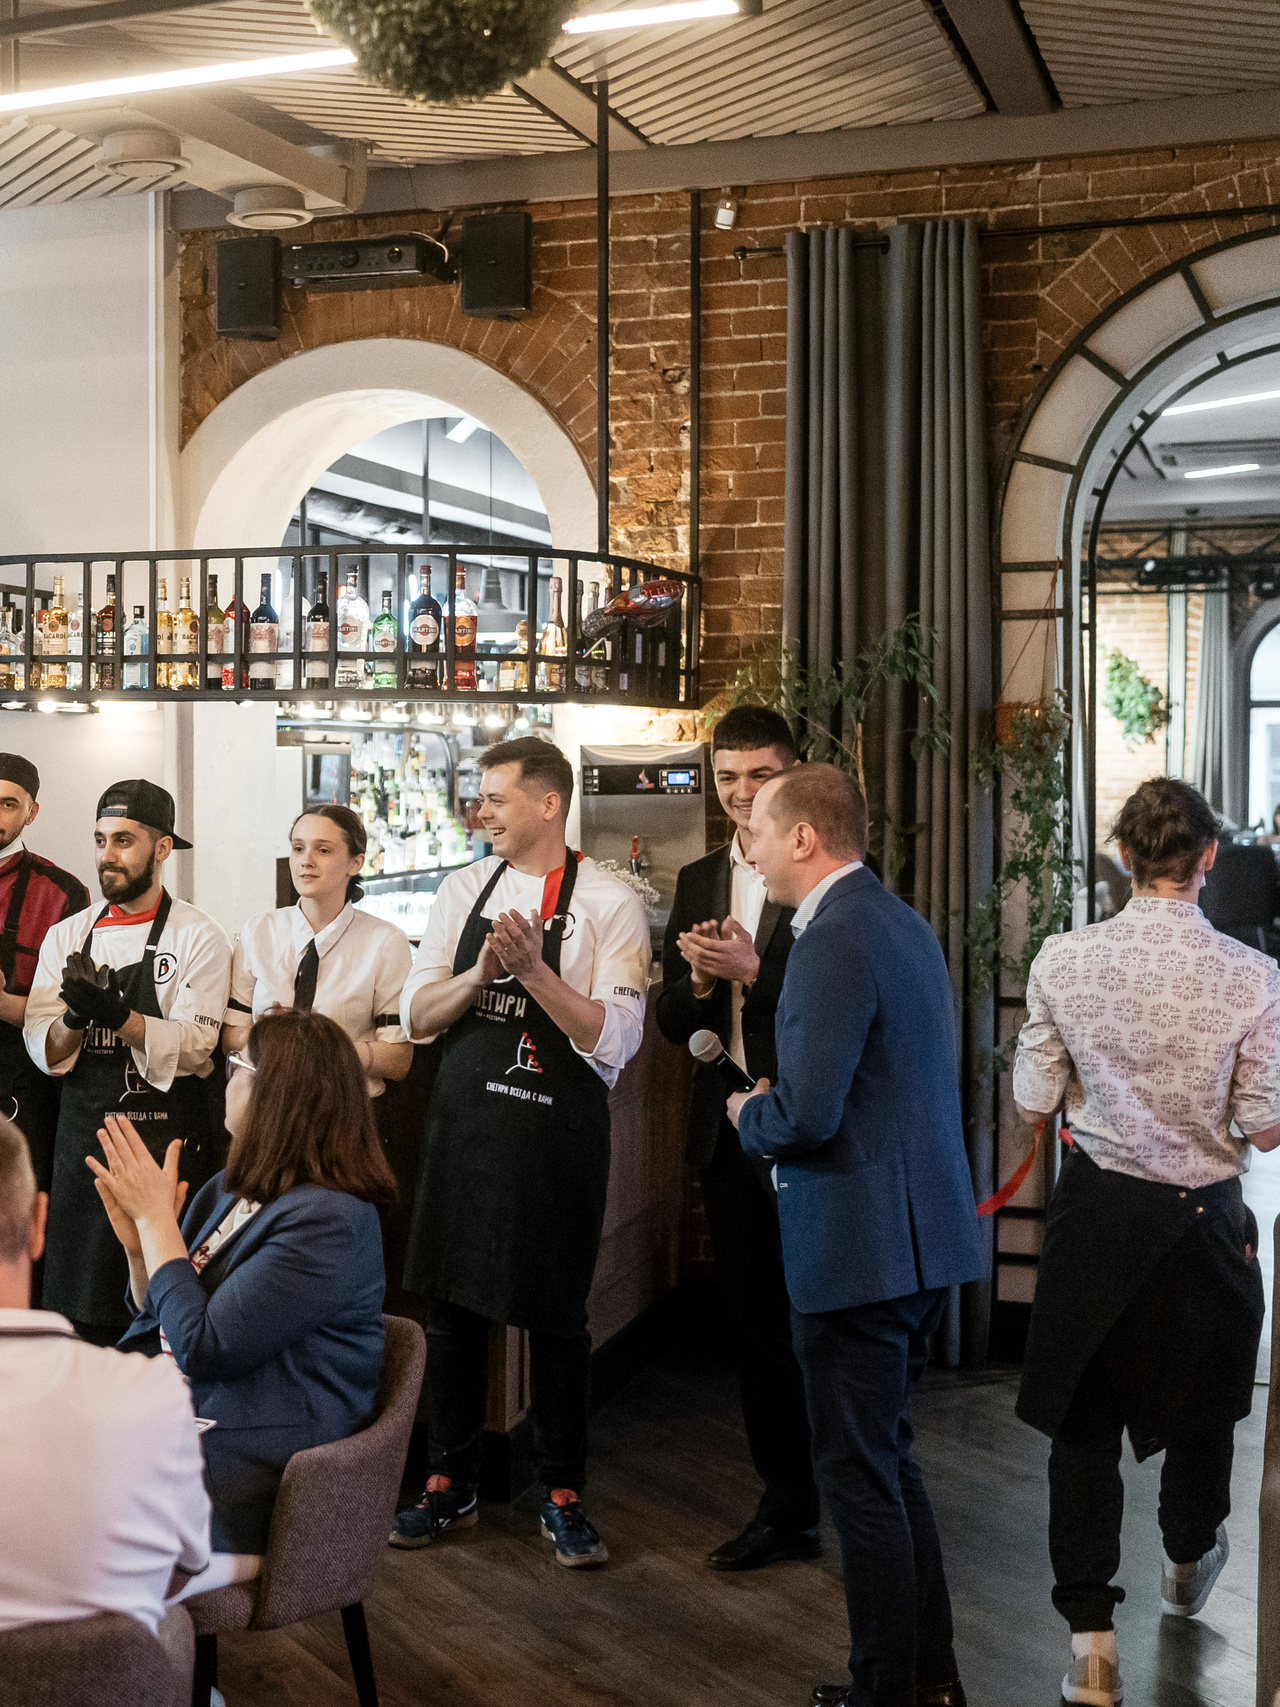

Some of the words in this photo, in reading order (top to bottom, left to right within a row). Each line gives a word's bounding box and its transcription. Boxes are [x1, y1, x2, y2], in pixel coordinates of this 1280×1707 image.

[509, 1086, 531, 1100] ВСЕГДА
[532, 1092, 538, 1101] С
[537, 1093, 554, 1106] ВАМИ
[148, 1111, 154, 1120] С
